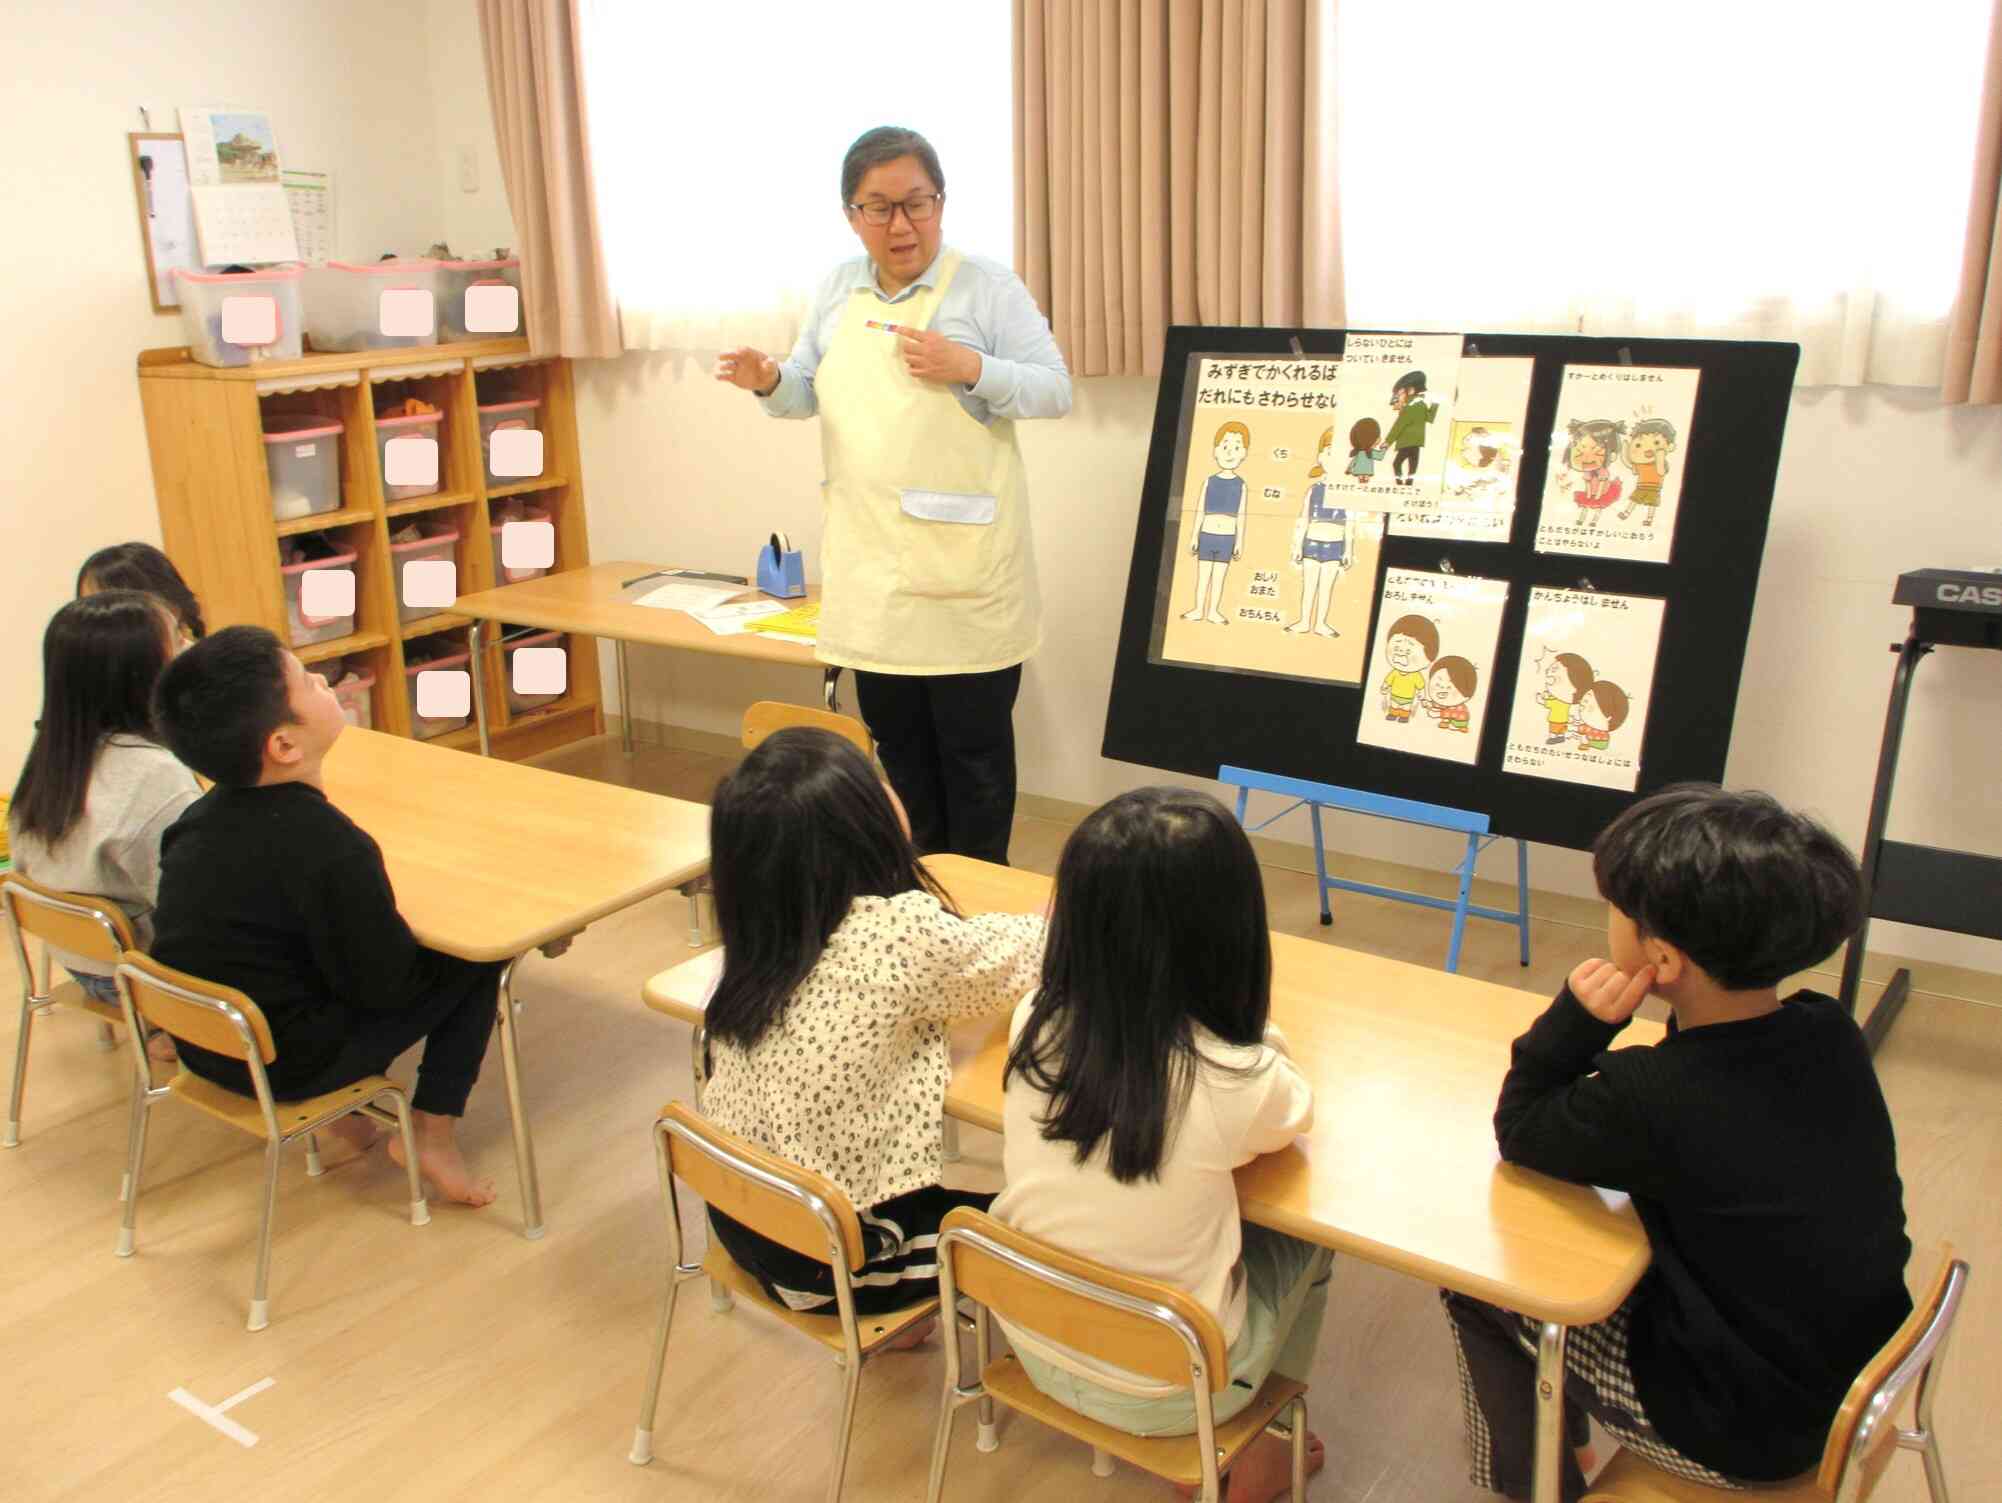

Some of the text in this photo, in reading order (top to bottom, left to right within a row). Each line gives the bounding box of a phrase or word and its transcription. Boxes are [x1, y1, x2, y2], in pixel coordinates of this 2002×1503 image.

[1273, 448, 1288, 459] くち
[1264, 487, 1281, 499] むね
[1254, 572, 1278, 582] おしり
[1250, 585, 1277, 597] おまた
[1239, 608, 1281, 622] おちんちん
